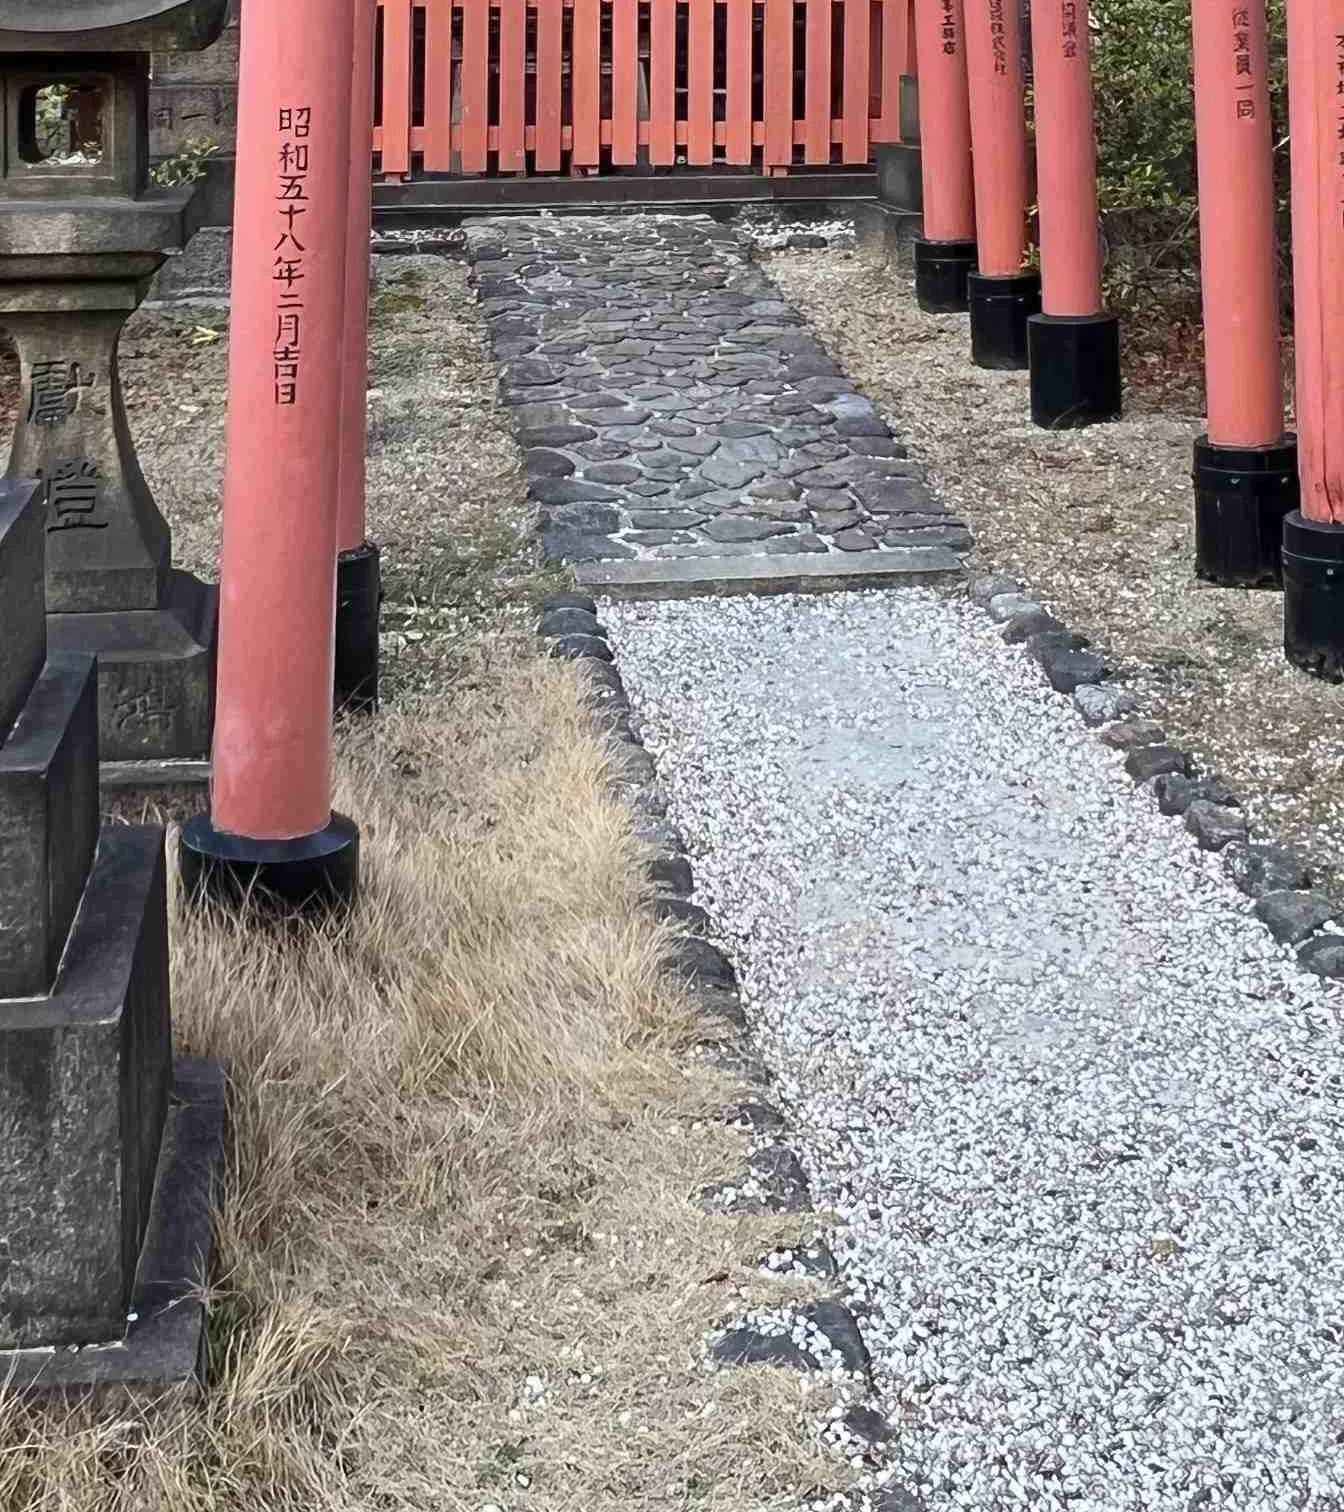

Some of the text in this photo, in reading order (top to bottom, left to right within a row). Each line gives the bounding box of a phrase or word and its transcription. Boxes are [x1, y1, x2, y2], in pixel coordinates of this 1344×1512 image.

[272, 106, 312, 405] 昭和五十八年二月吉日
